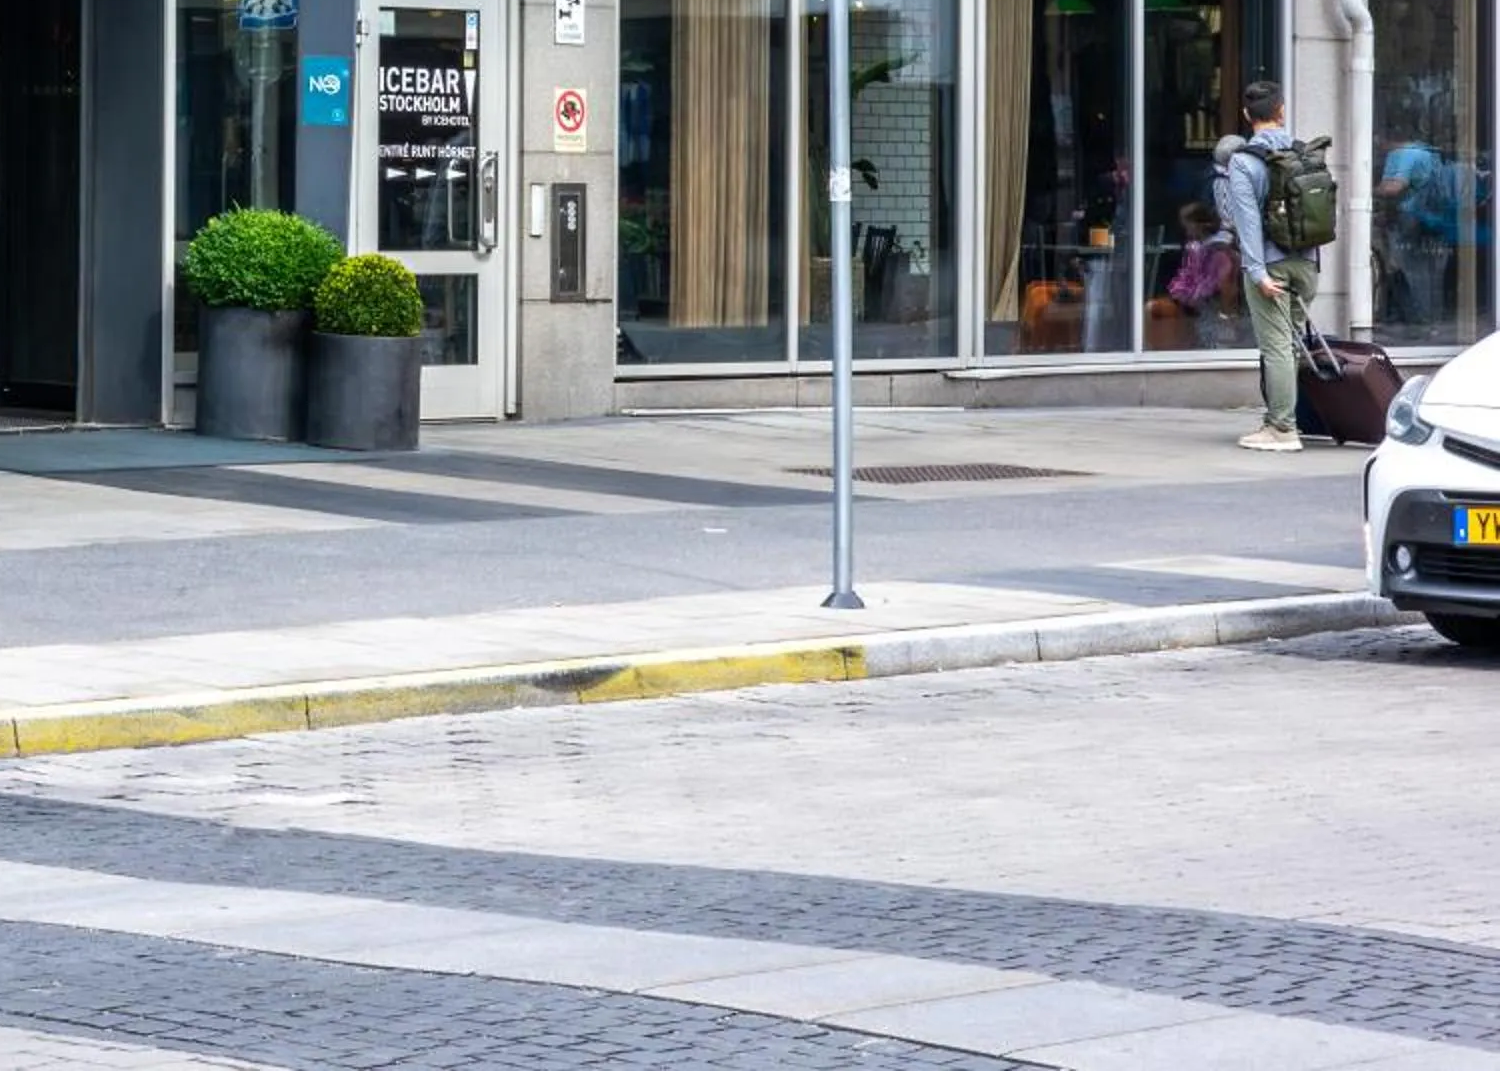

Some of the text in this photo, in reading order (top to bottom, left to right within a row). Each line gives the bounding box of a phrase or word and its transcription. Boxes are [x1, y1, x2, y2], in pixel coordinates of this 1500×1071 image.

[379, 66, 460, 94] ICEBAR
[379, 94, 461, 113] STOCKHOLM
[411, 144, 437, 157] RUNT
